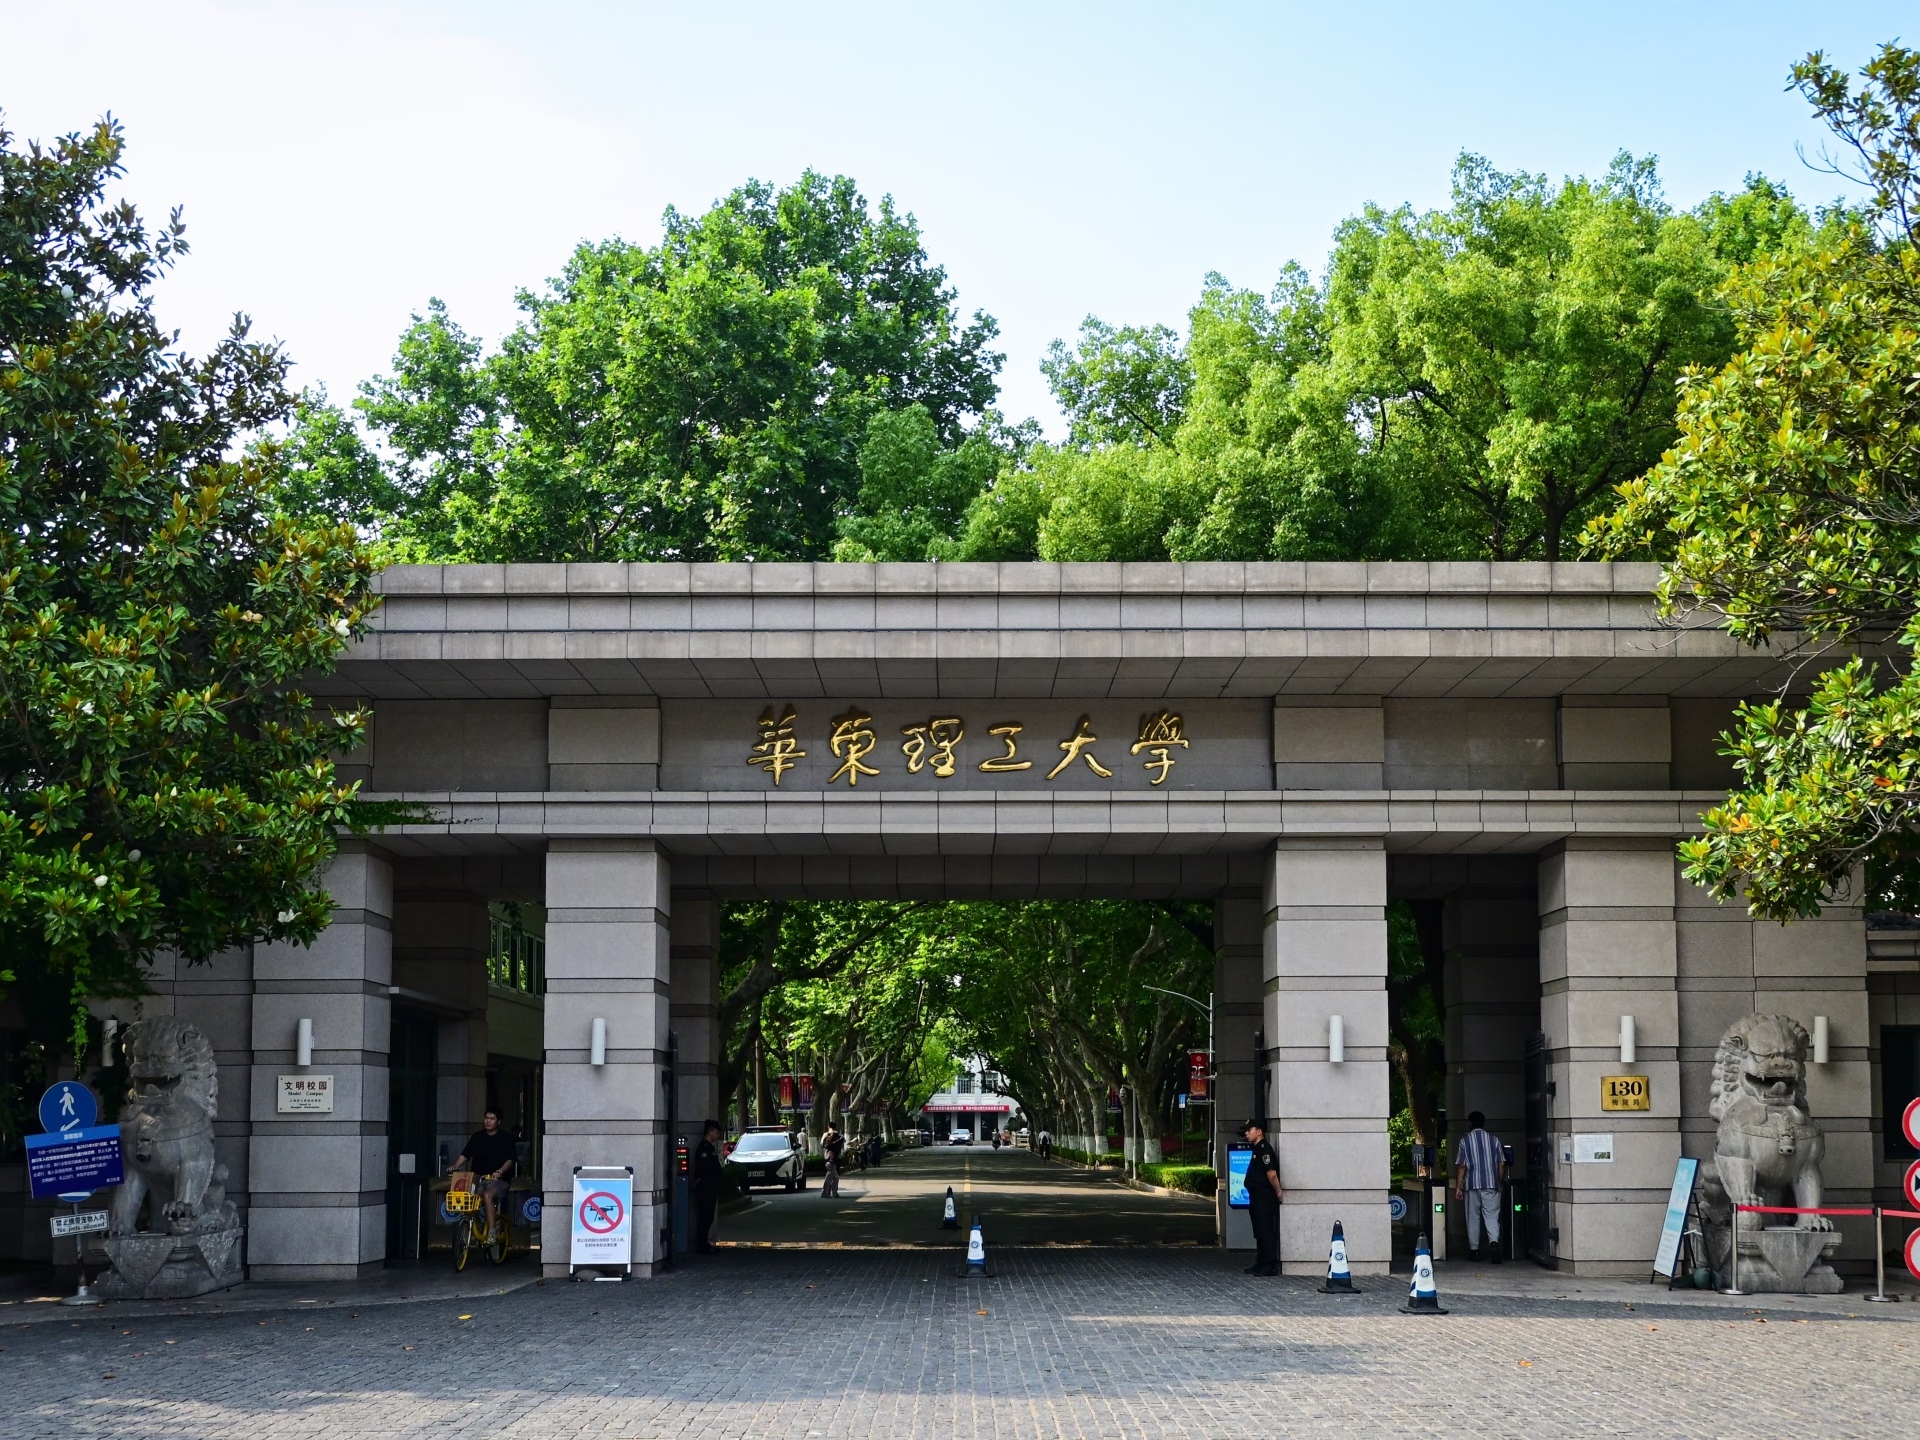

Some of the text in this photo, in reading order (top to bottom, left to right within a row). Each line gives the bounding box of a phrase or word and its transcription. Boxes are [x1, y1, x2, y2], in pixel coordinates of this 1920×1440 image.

[284, 1081, 327, 1091] 文明校园
[1609, 1081, 1643, 1096] 130
[83, 1222, 105, 1230] allowed
